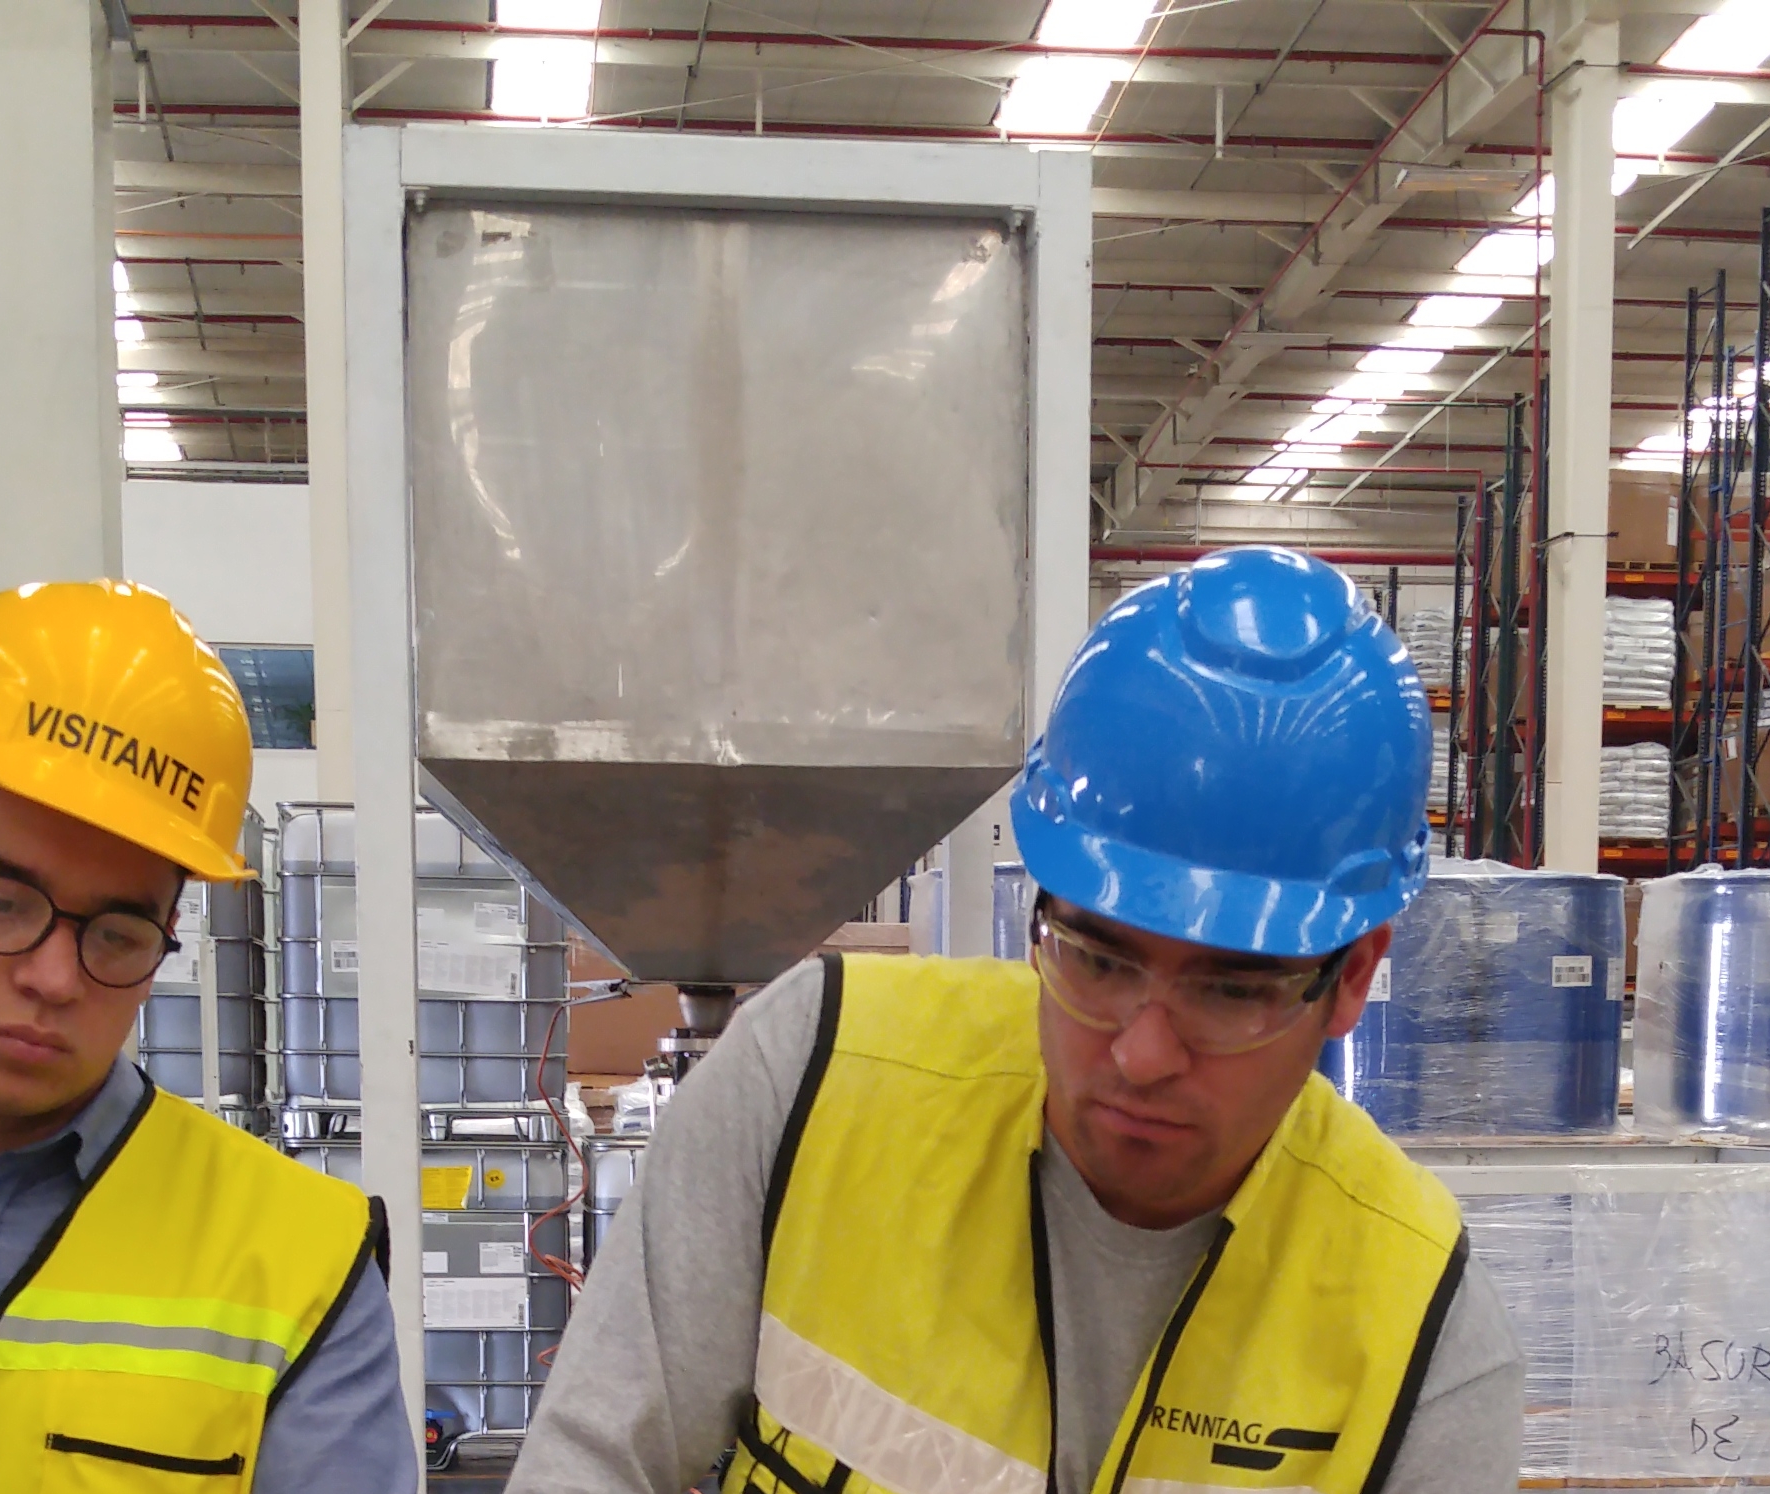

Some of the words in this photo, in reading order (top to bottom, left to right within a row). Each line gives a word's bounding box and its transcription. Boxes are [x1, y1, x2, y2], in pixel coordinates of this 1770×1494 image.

[26, 700, 205, 812] VISITANTE
[1150, 1404, 1264, 1445] RENNTAG
[1691, 1414, 1741, 1462] DE
